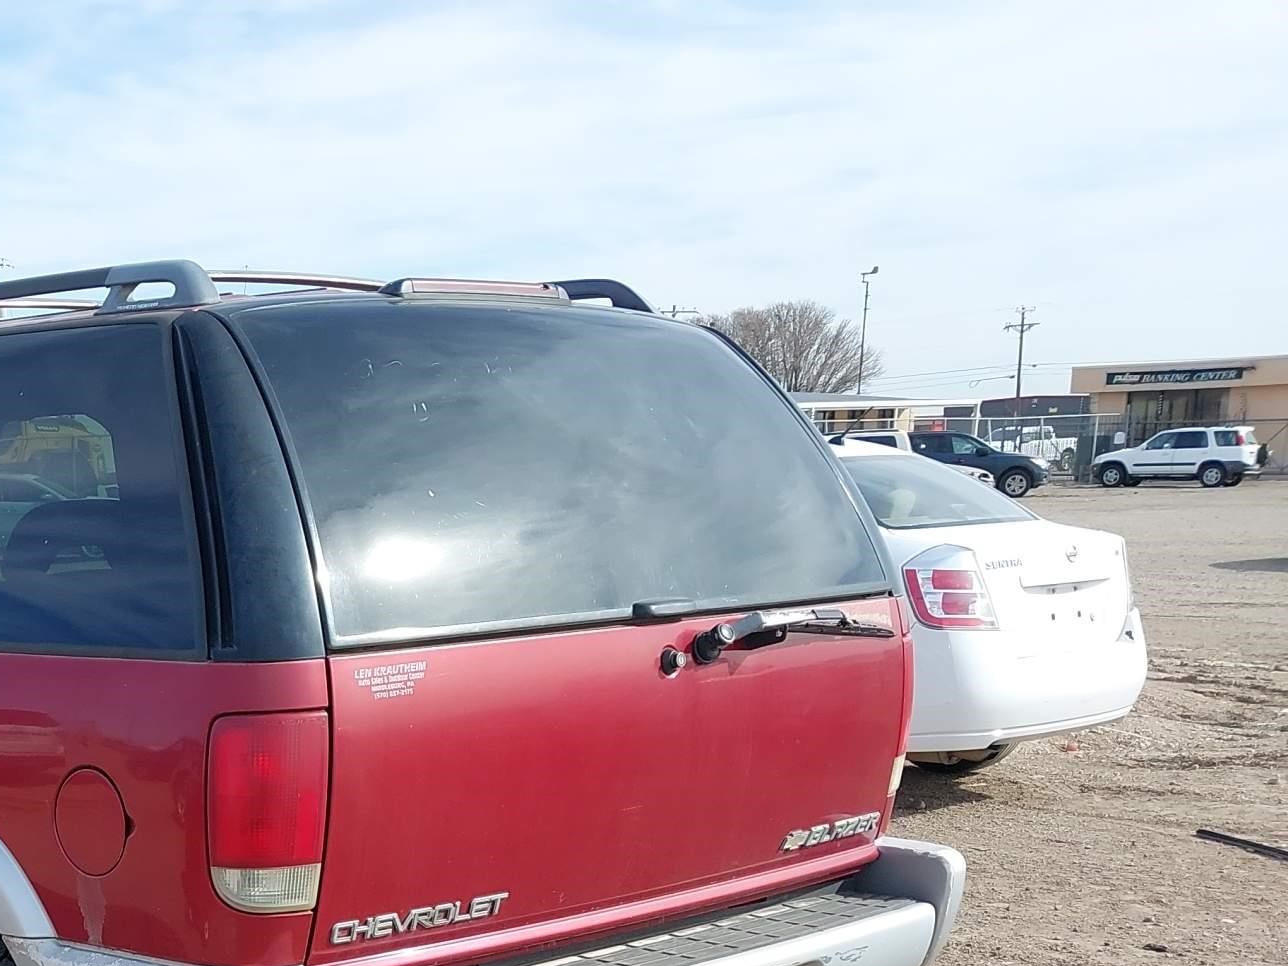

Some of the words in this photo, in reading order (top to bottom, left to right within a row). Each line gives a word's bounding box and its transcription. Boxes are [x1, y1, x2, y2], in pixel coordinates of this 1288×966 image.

[1142, 372, 1191, 384] BANKING
[1192, 369, 1237, 381] CENTER
[985, 558, 1023, 570] SENTRA
[354, 668, 372, 679] LEN
[373, 661, 427, 677] KRAUTHEIM
[805, 811, 881, 847] BLAZER
[331, 892, 509, 945] CHEVROLET
